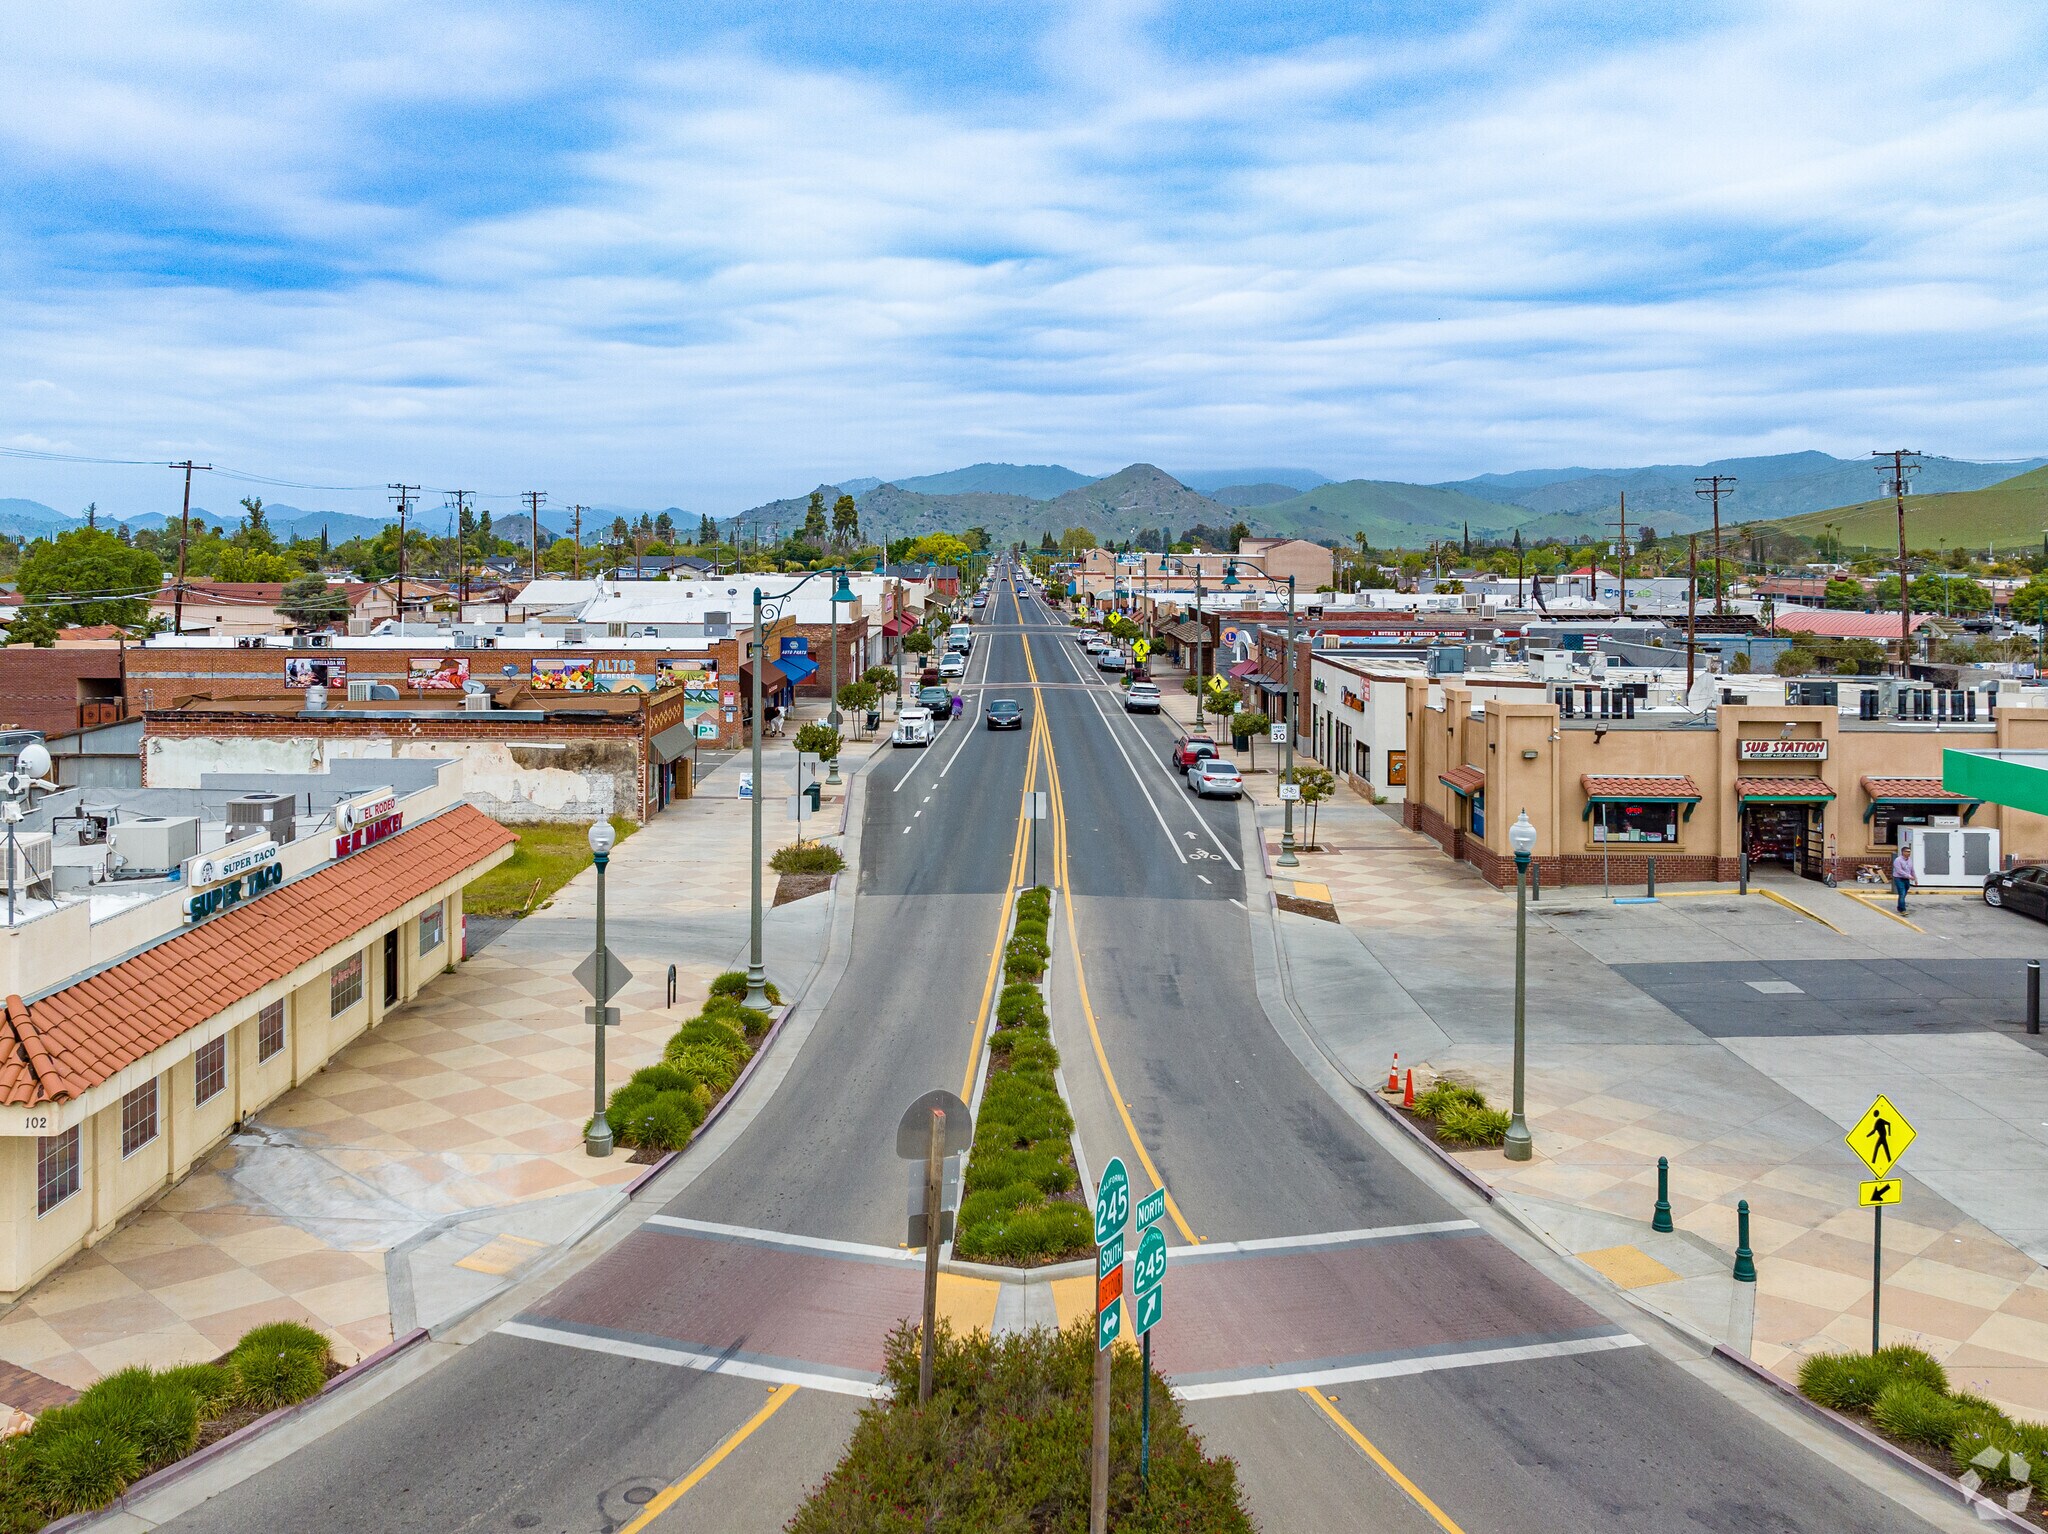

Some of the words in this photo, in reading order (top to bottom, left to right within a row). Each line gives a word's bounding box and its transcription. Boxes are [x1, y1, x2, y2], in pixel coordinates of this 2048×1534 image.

[1614, 589, 1634, 598] RTE
[1635, 589, 1652, 598] AID
[1228, 633, 1235, 641] L
[596, 659, 636, 672] ALTOS
[699, 726, 708, 736] P
[1273, 733, 1286, 741] 30
[1744, 741, 1769, 753] SUB
[1772, 741, 1825, 753] STATION
[364, 805, 373, 819] EL
[375, 798, 396, 816] RODEO
[336, 828, 363, 858] MEAT
[364, 811, 403, 846] MARKET
[223, 858, 252, 876] SUPER
[253, 847, 276, 862] TACO
[190, 879, 242, 923] SUPER
[249, 862, 283, 896] TACO
[25, 1117, 47, 1129] 102
[1100, 1174, 1125, 1196] CALIFORNIA
[1097, 1184, 1127, 1236] 245
[1138, 1196, 1163, 1227] NORTH
[1138, 1233, 1162, 1254] CALIFORNIA
[1102, 1240, 1123, 1272] SOUTH
[1136, 1246, 1164, 1290] 245
[1101, 1273, 1121, 1302] DETOUR
